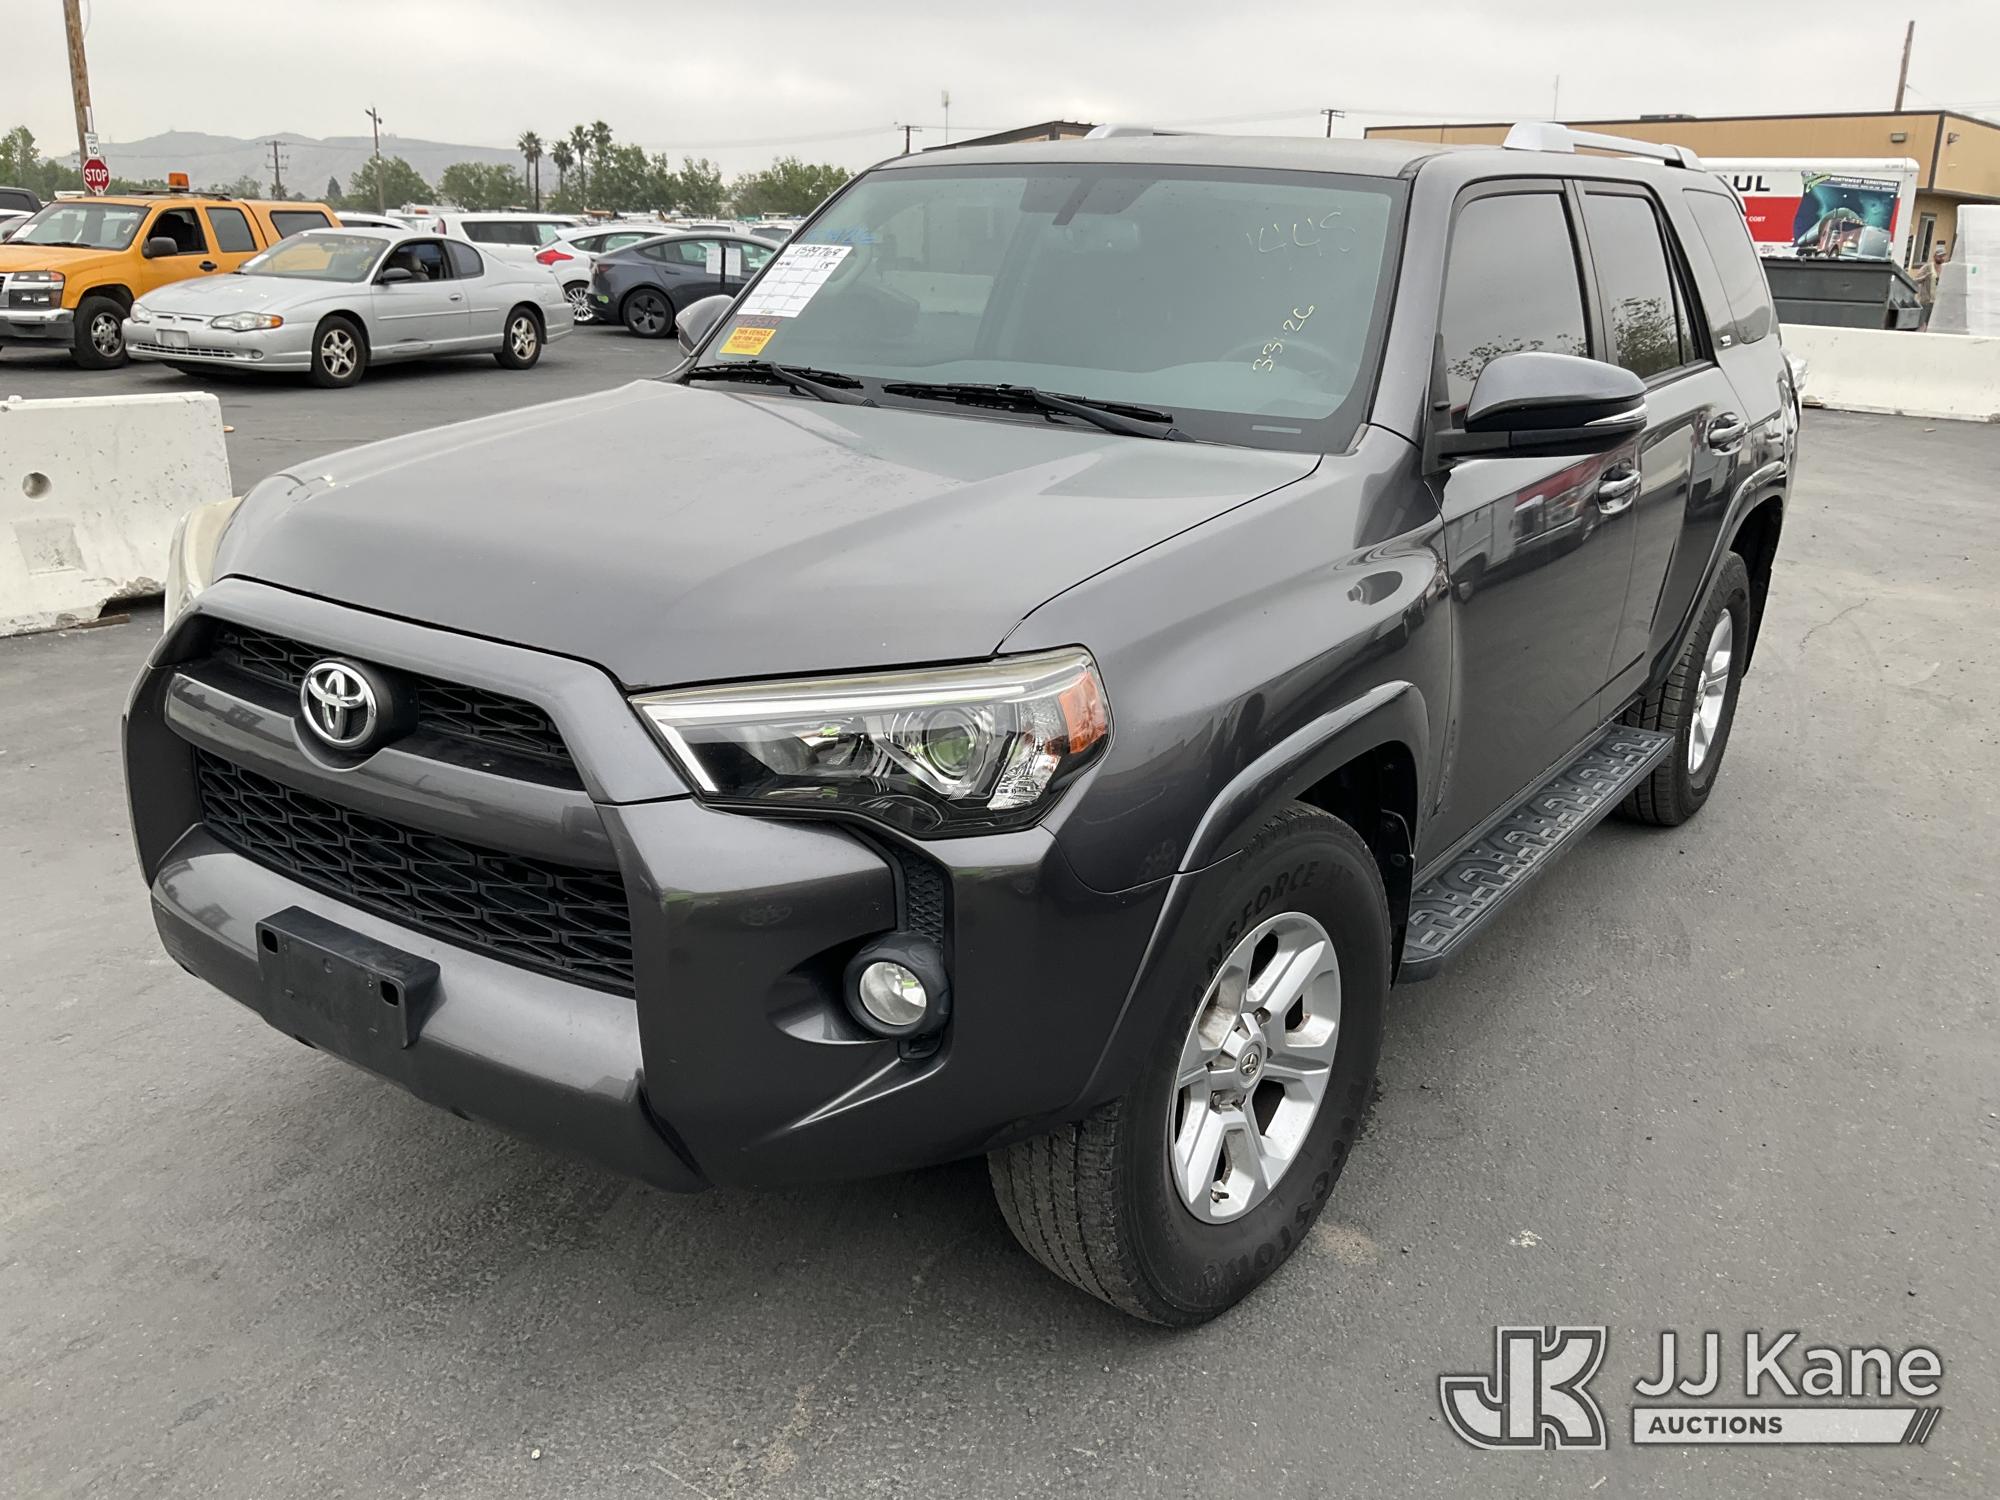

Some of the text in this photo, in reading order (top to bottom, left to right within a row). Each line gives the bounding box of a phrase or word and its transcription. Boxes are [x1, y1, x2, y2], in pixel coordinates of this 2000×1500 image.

[90, 146, 98, 155] 10
[85, 168, 108, 182] STOP
[1723, 175, 1771, 192] UL
